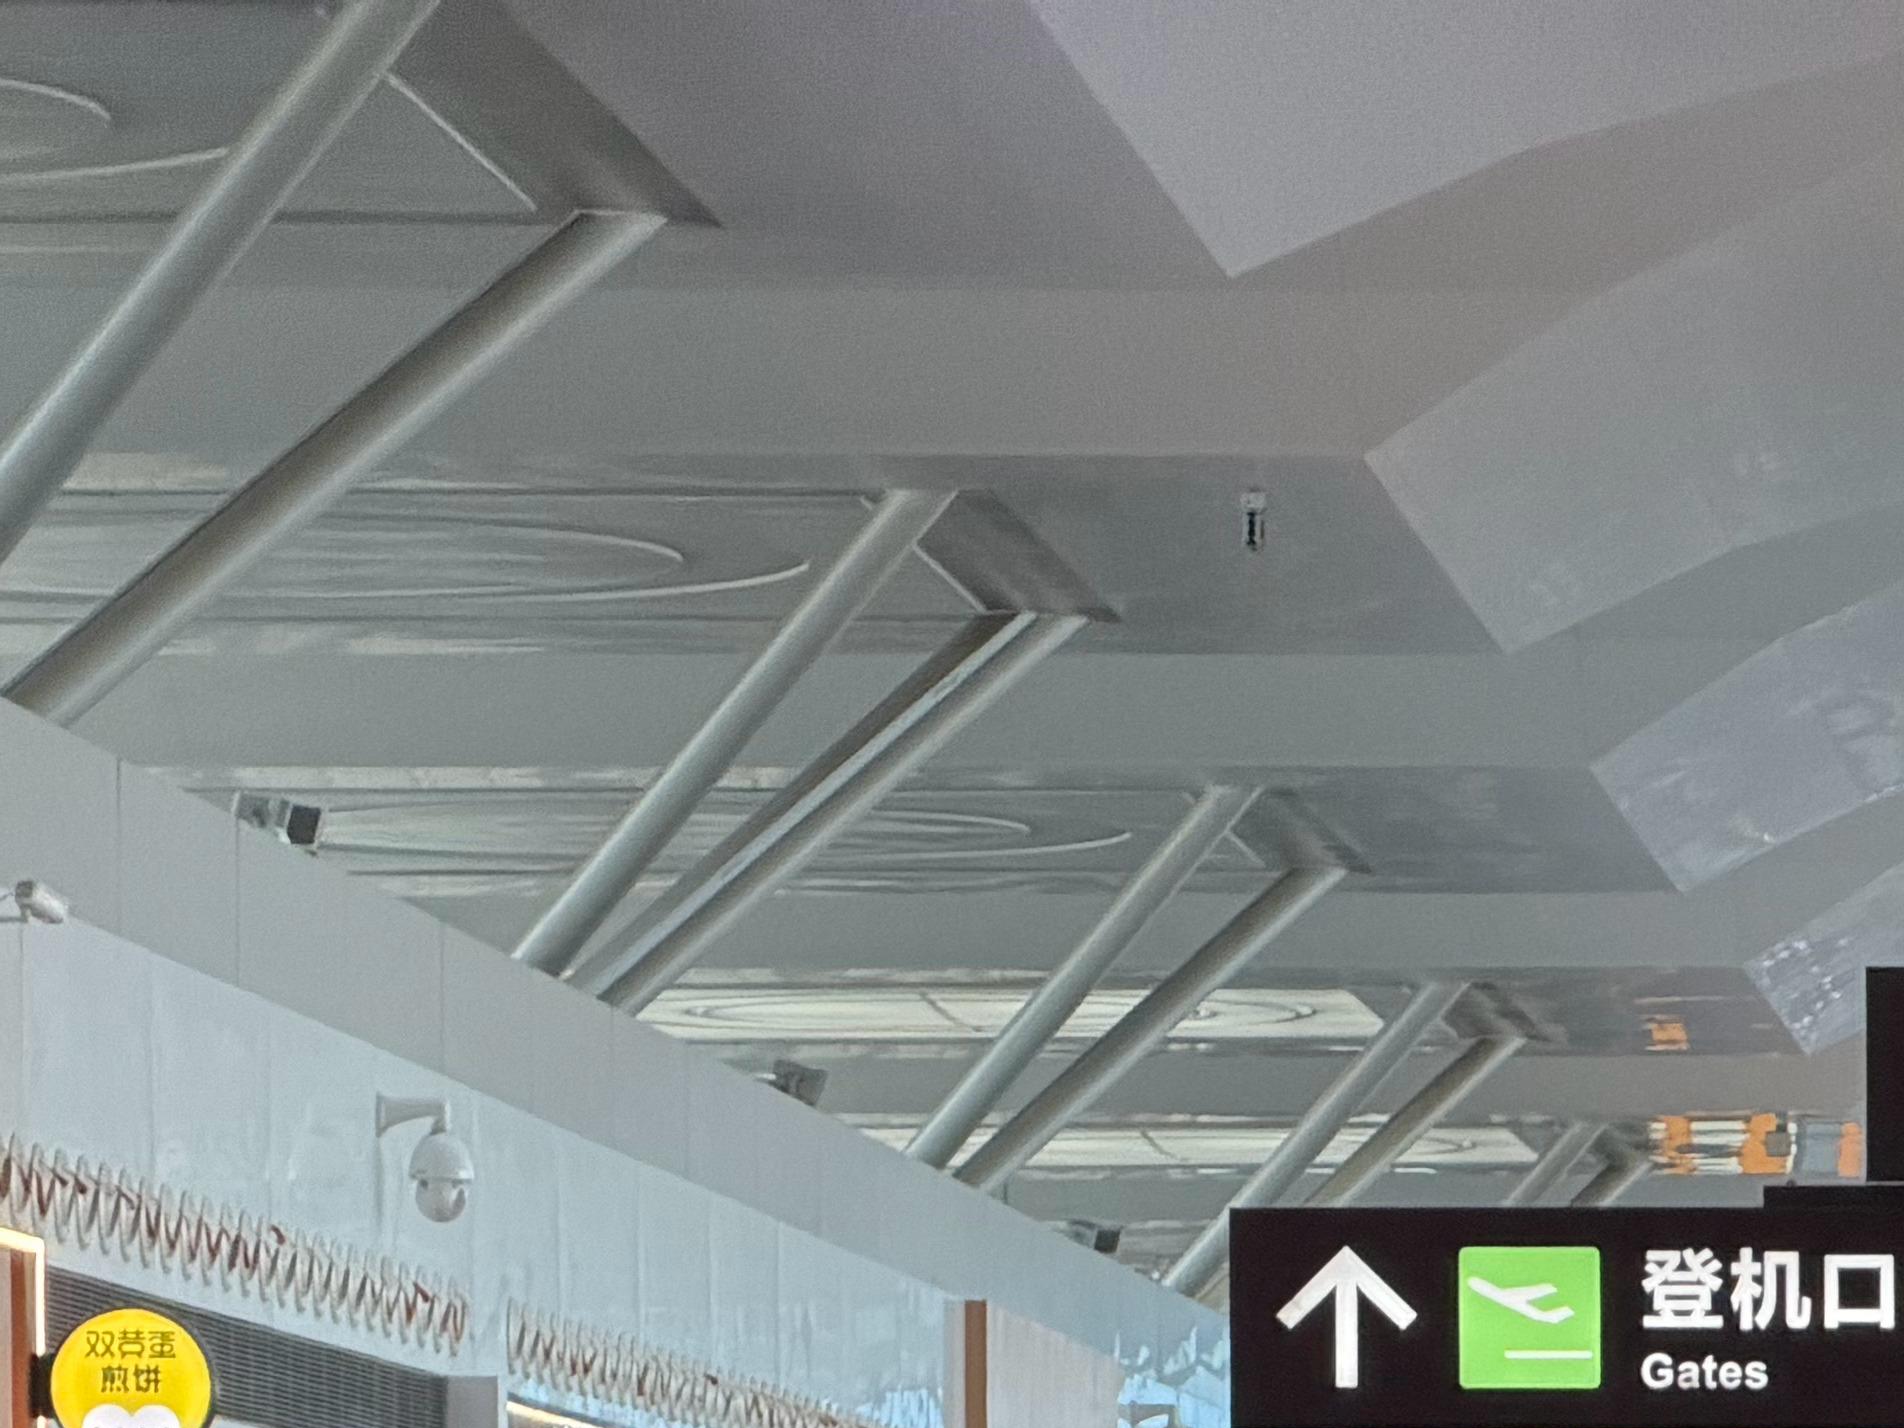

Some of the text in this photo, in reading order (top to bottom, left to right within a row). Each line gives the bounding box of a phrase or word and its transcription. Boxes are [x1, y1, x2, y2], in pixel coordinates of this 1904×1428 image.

[1641, 1249, 1896, 1332] 登机口
[101, 1364, 162, 1393] 煎饼
[1641, 1354, 1768, 1391] Gates
